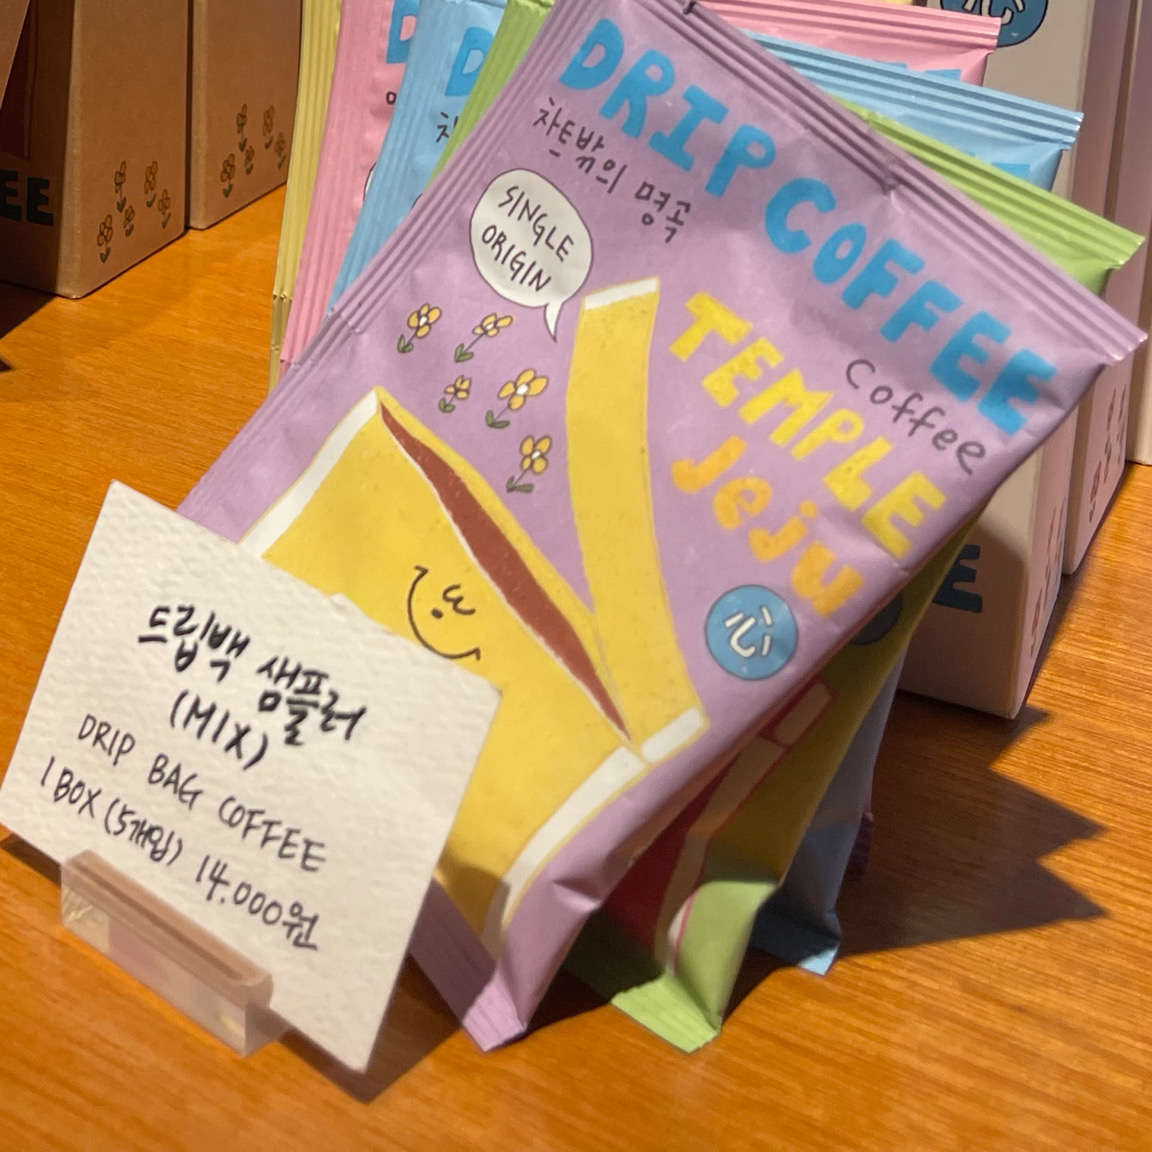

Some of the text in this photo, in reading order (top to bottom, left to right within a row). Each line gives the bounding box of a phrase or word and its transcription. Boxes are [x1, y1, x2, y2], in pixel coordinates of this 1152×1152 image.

[481, 224, 552, 294] ORIGIN
[498, 185, 574, 263] SINGLE
[558, 18, 1057, 436] DRIP COFFEE
[635, 181, 692, 244] 명곡
[668, 291, 946, 561] TEMPLE
[845, 358, 987, 475] Coffee
[671, 435, 864, 618] Jeju
[138, 604, 367, 746] 드립백 샘플러
[170, 689, 269, 771] (MIX)
[77, 714, 327, 872] DRIP BAG COFFEE
